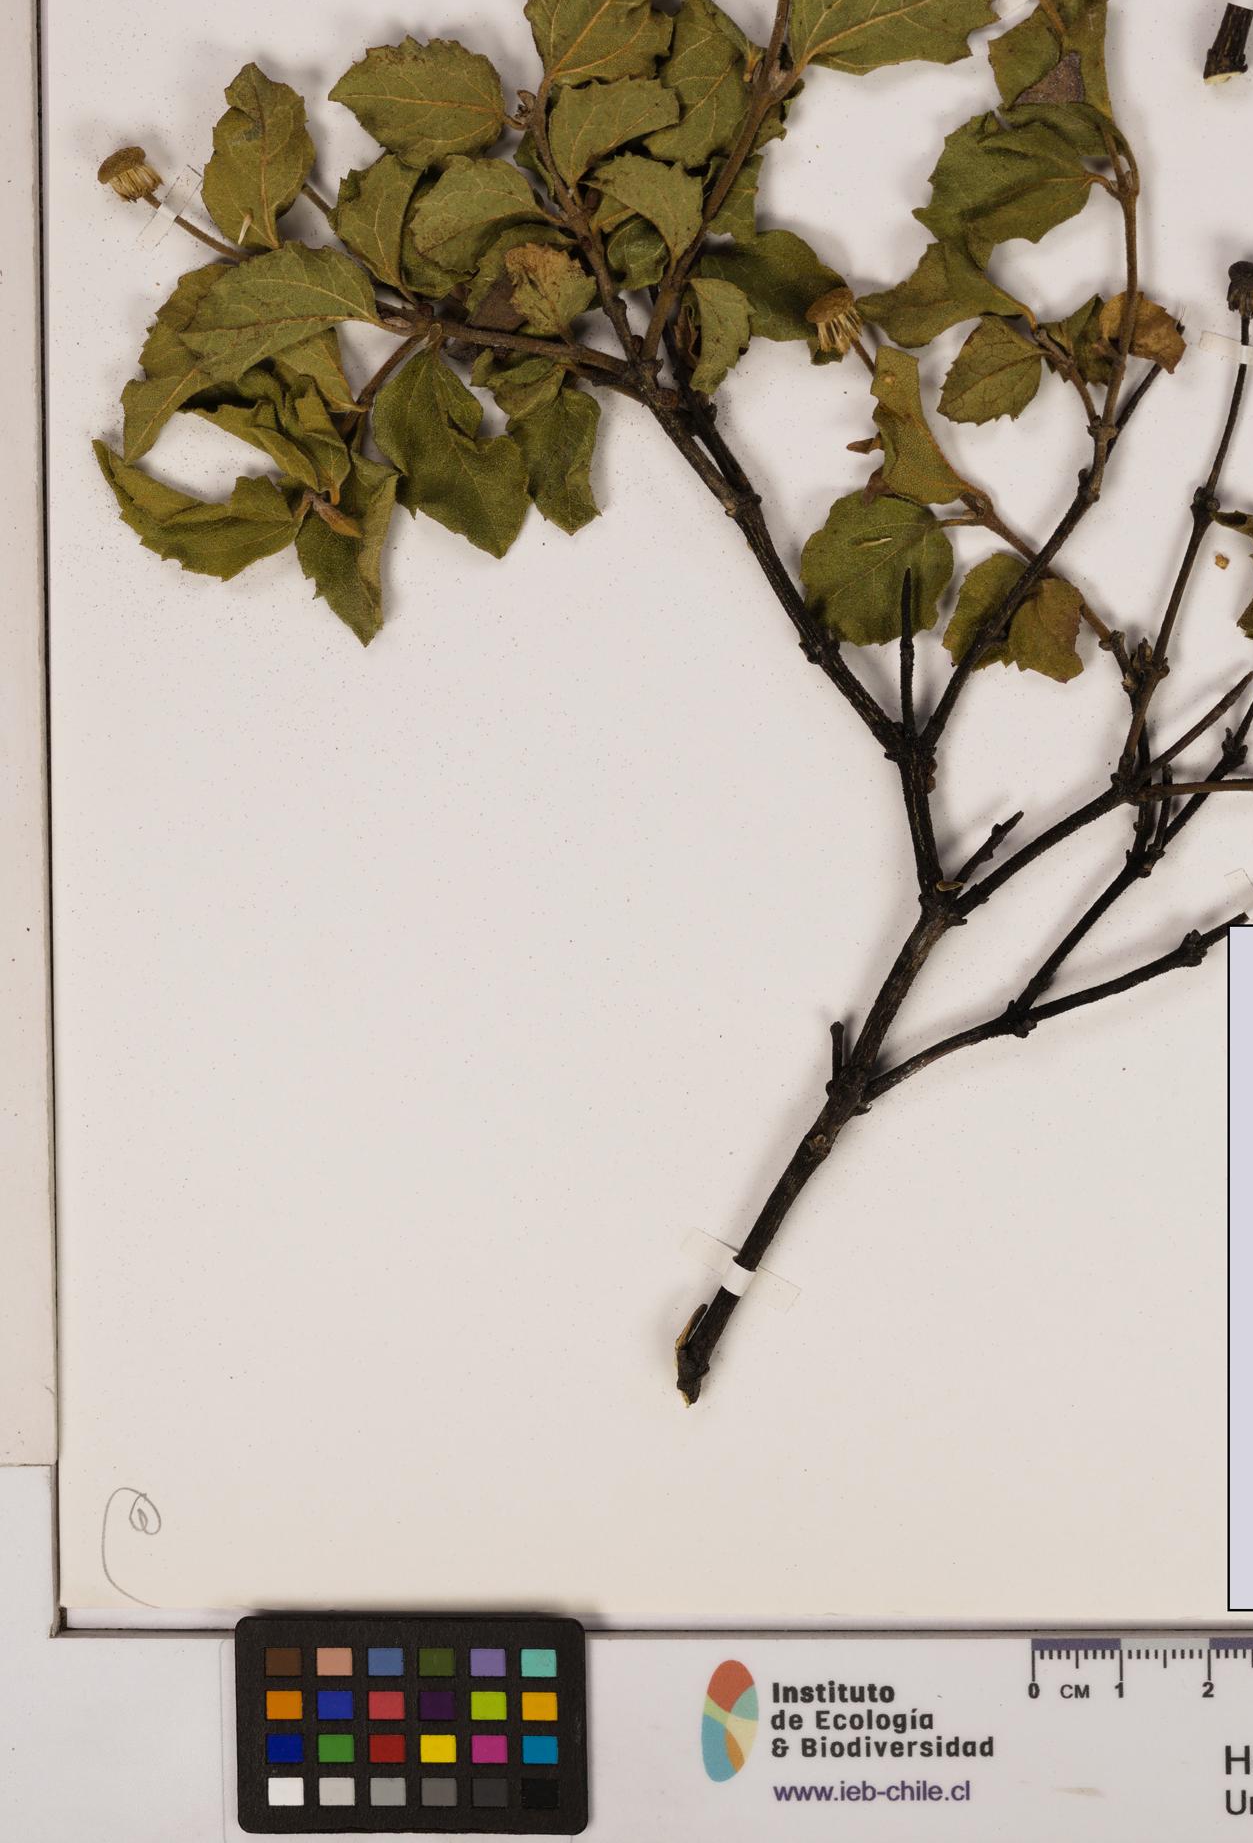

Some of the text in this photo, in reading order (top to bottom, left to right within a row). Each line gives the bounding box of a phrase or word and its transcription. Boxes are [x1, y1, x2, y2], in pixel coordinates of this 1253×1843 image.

[772, 1679, 896, 1704] Instituto
[1027, 1681, 1041, 1700] 0
[1058, 1683, 1092, 1700] CM
[1114, 1681, 1126, 1699] 1
[1201, 1681, 1216, 1699] 2
[770, 1707, 934, 1735] de Ecología
[771, 1735, 994, 1758] & Biodiversidad
[772, 1779, 971, 1802] www.ieb-chile.cl
